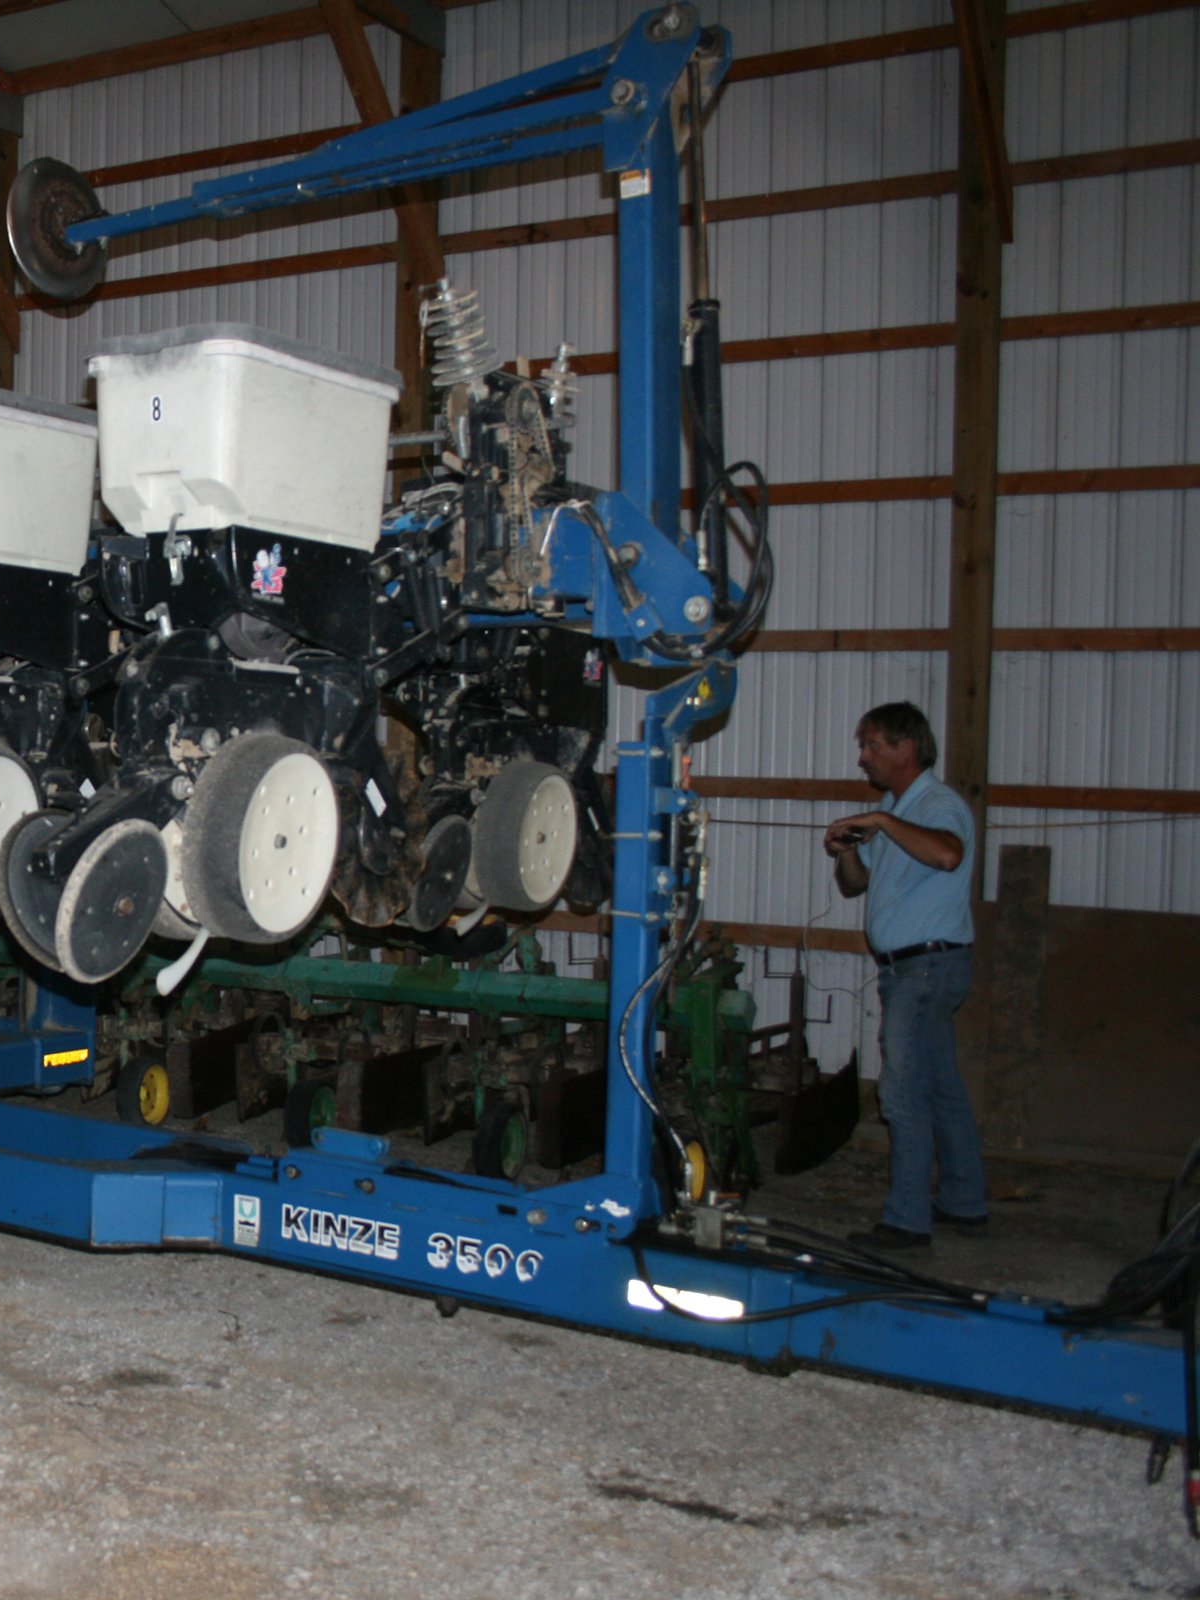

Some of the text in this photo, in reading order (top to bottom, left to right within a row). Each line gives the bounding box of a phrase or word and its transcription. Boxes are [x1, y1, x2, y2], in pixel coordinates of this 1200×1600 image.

[151, 396, 162, 422] 8
[281, 1203, 544, 1283] KINZE 3500
